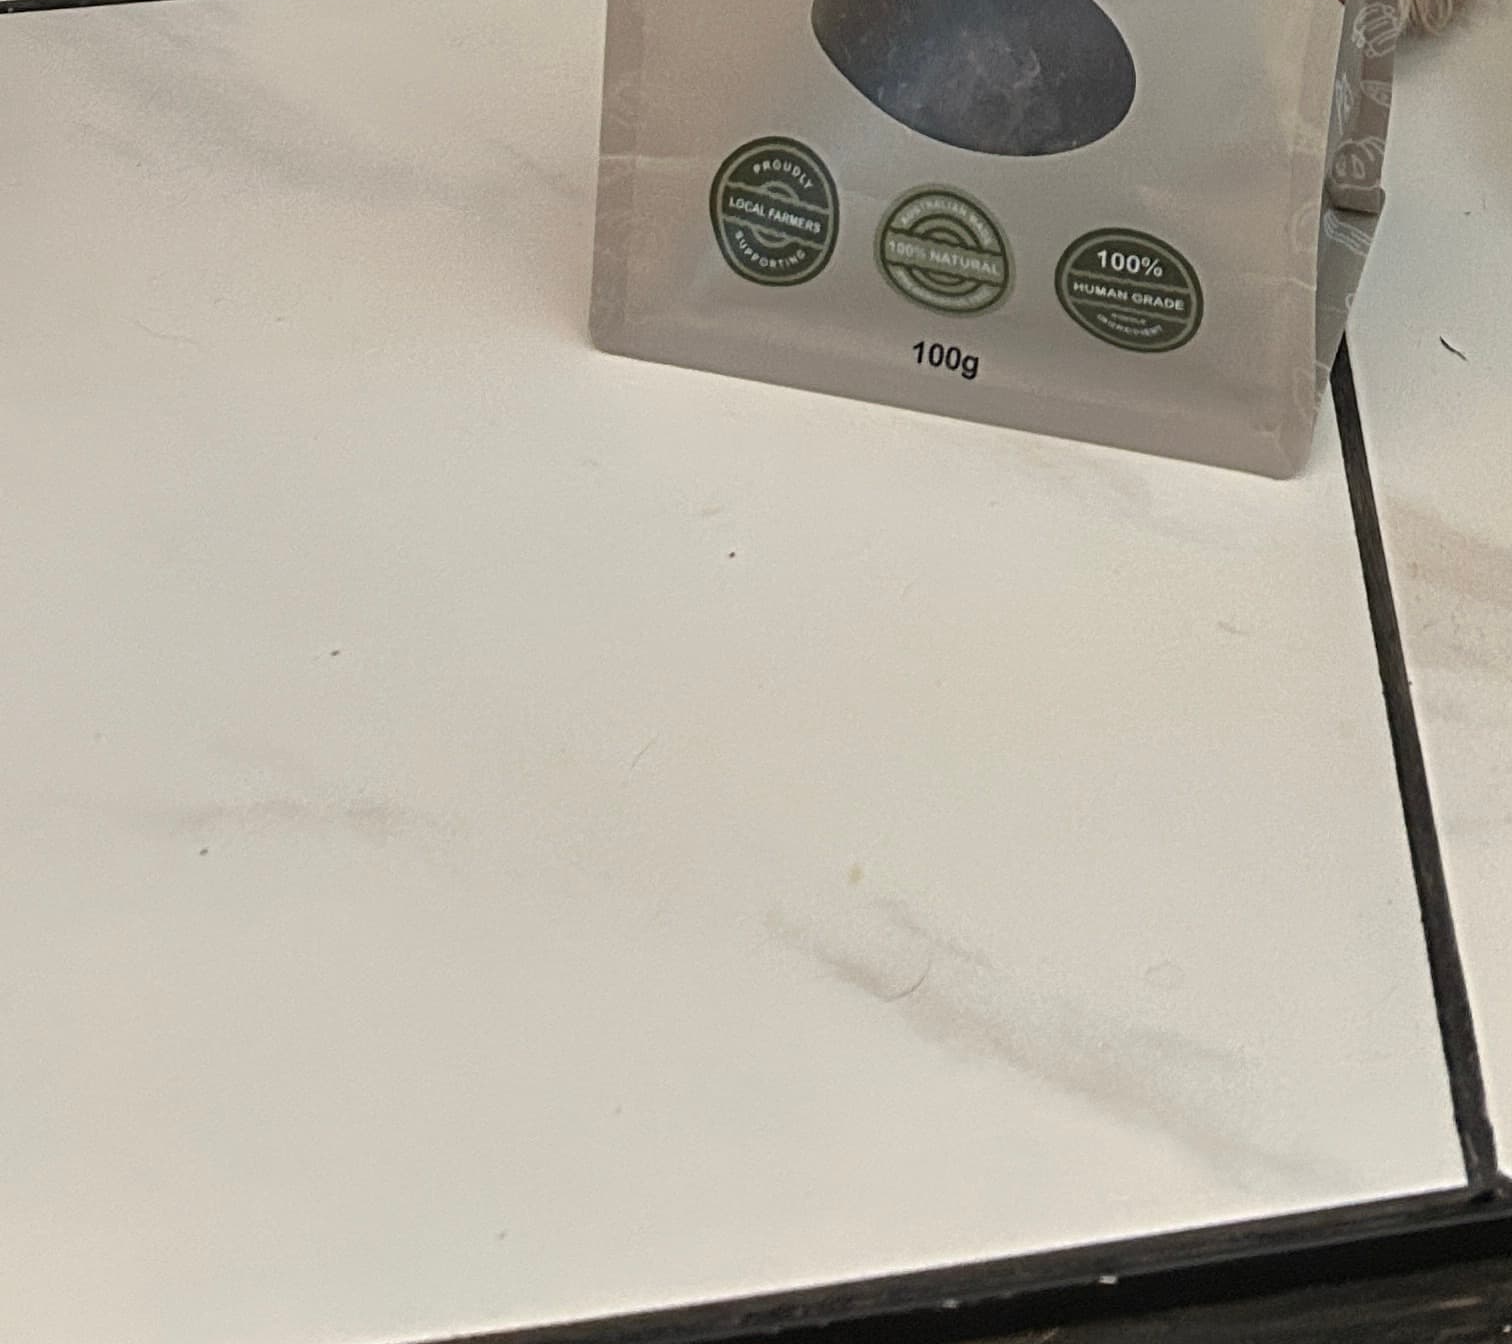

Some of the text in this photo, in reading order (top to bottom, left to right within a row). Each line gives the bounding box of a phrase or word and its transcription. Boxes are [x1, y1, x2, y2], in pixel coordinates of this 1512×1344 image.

[753, 159, 814, 189] PROUDLY
[728, 196, 822, 234] LOCAL FARMERS
[735, 229, 806, 268] SUPPORTING
[929, 250, 999, 275] NATURAL
[1096, 249, 1164, 278] 100%
[1073, 281, 1185, 311] HUMAN GRADE
[912, 340, 979, 381] 100g
